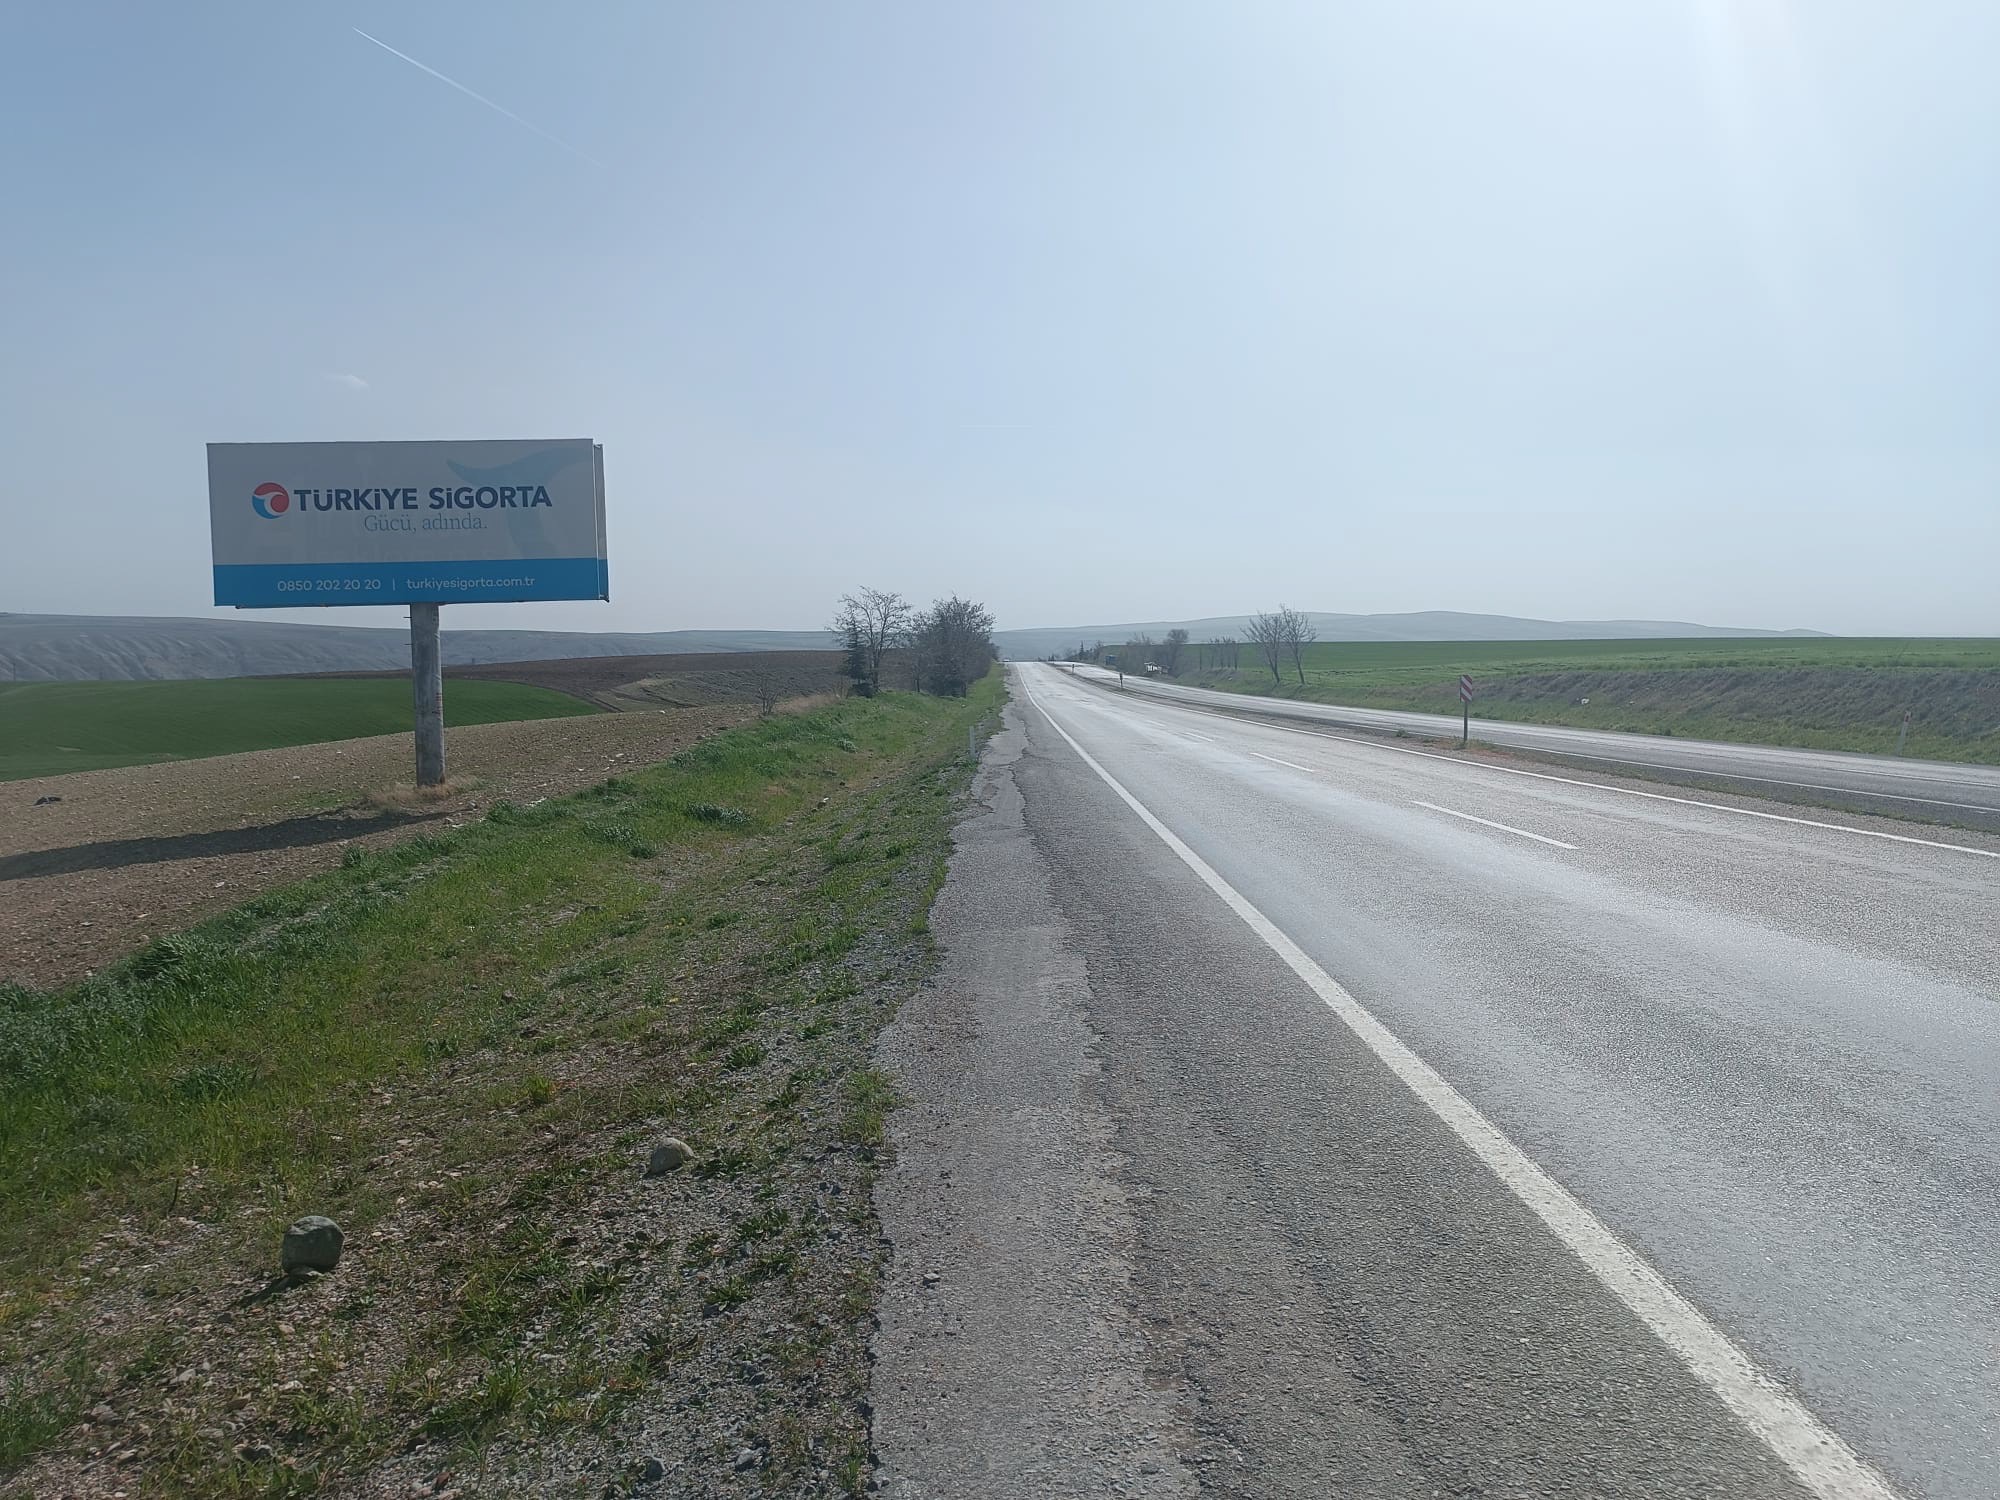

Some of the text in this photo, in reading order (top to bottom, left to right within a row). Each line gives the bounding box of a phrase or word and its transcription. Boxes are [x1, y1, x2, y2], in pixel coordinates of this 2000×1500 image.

[364, 512, 488, 533] Gücü, adında.
[277, 576, 535, 592] 0850 202 20 20 turkiyesigorta.com.tr
